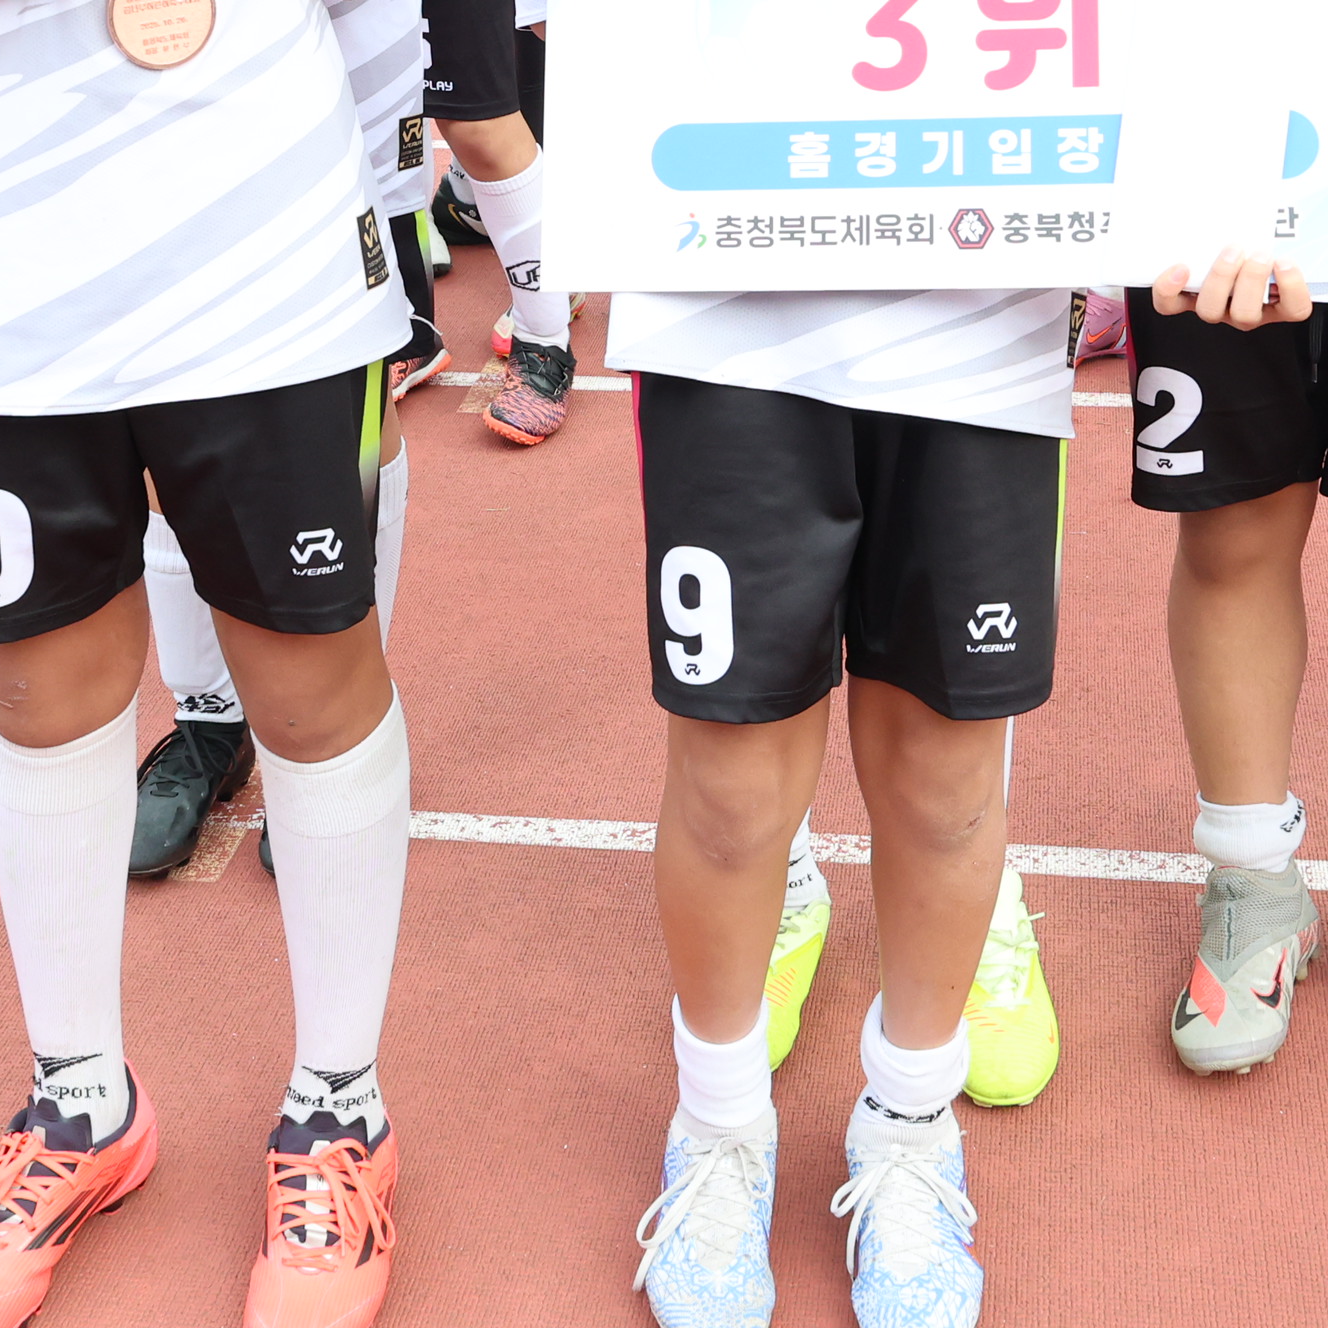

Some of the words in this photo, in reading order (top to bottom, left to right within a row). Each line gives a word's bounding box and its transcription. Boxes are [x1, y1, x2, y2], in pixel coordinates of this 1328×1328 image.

[715, 212, 936, 250] 충청북도체육회
[1136, 367, 1205, 476] 2
[292, 561, 344, 577] WERUN
[659, 545, 734, 686] 9
[966, 642, 1016, 653] WERUN
[46, 1081, 107, 1102] sport
[333, 1087, 377, 1112] sport
